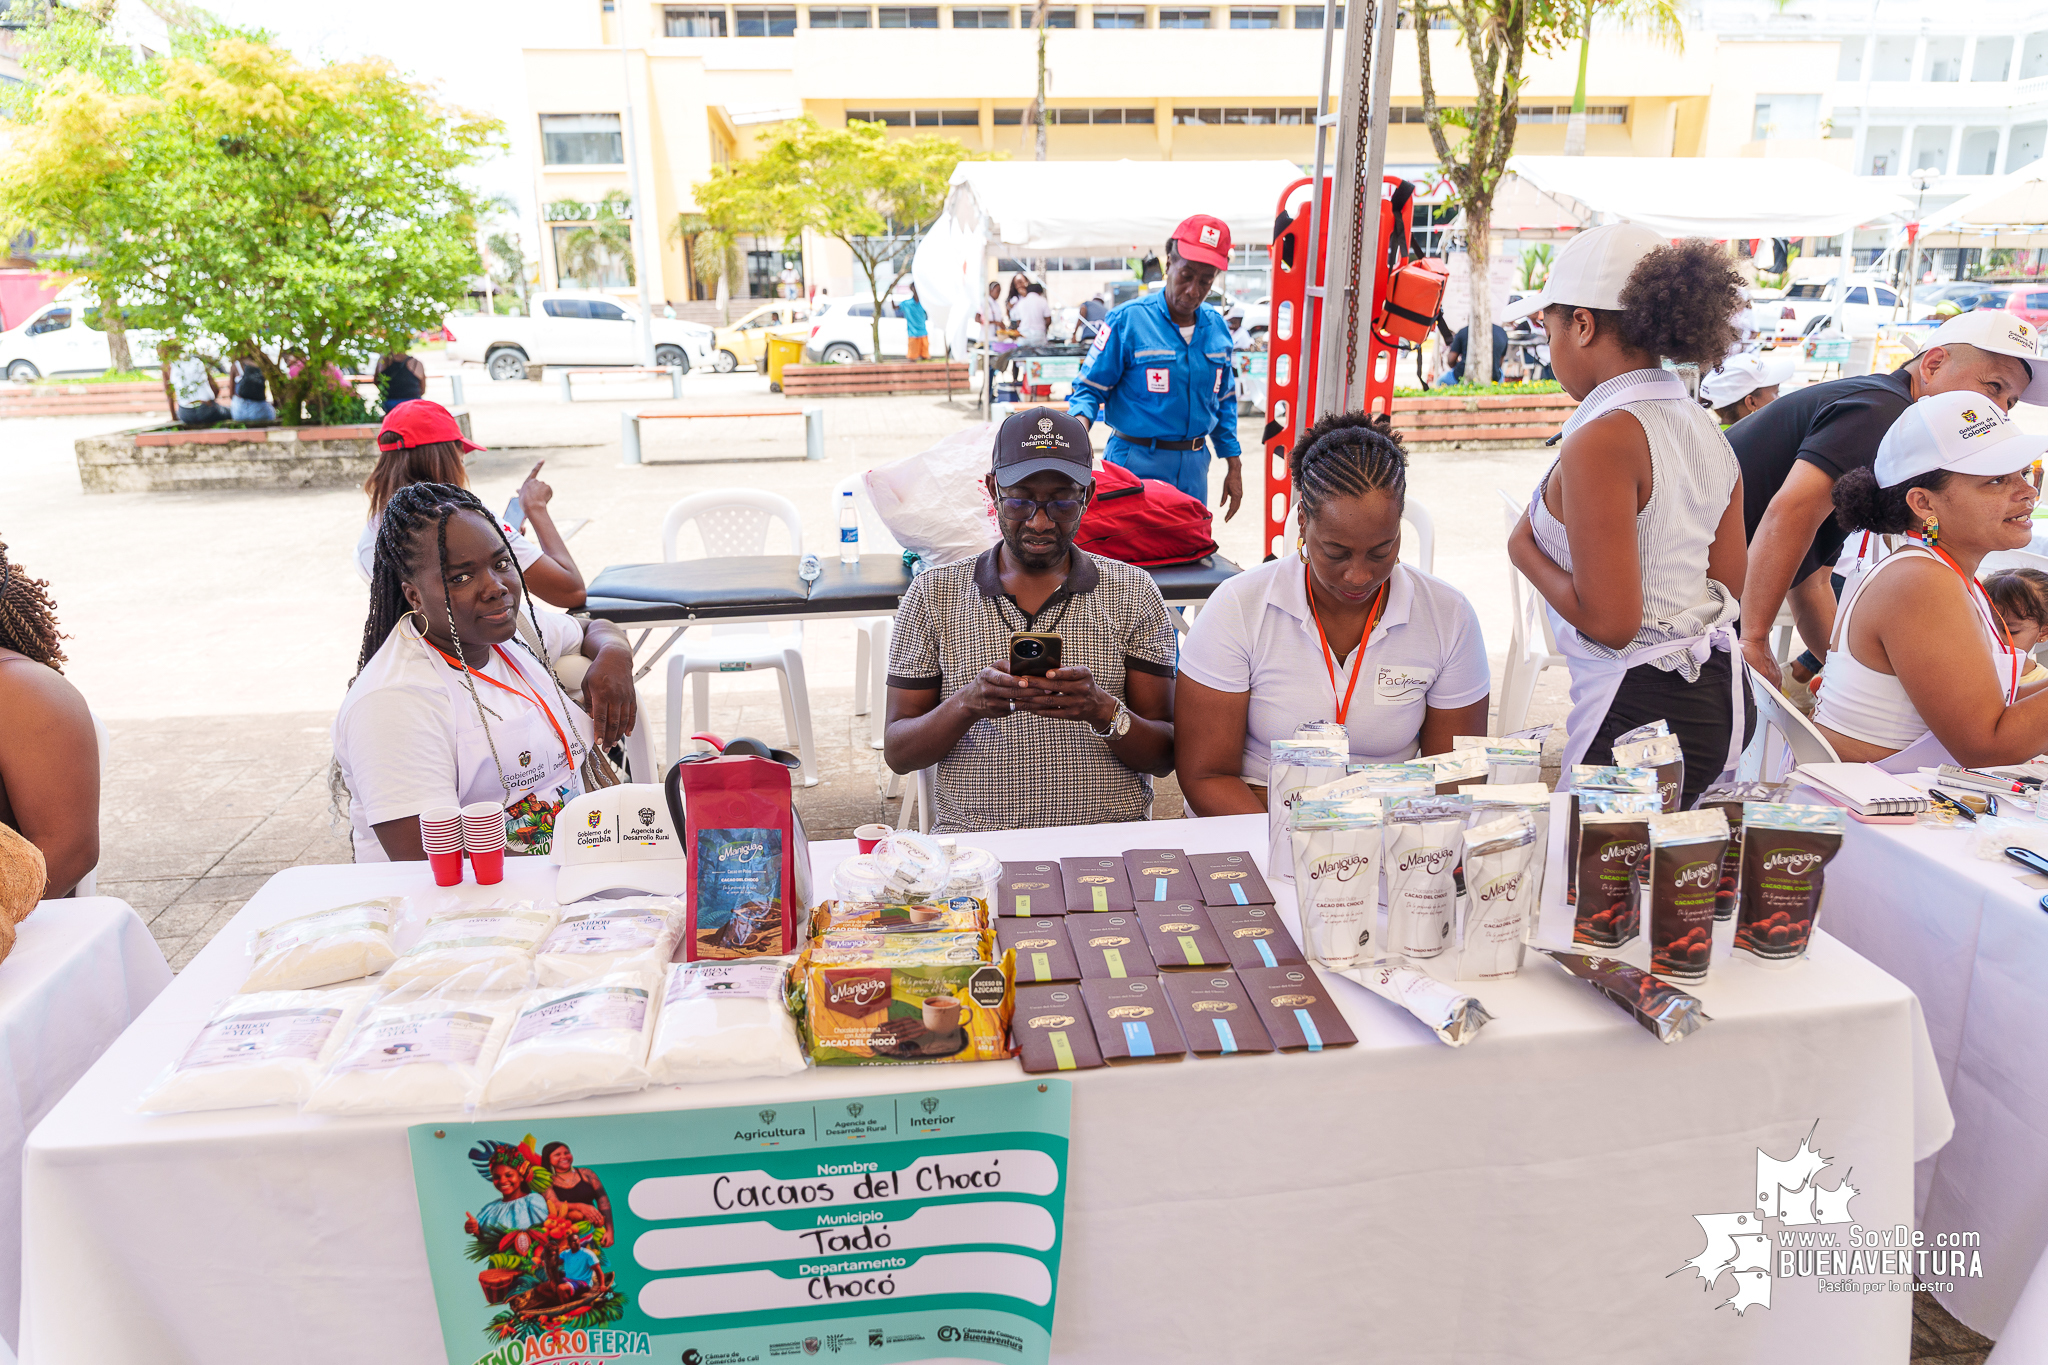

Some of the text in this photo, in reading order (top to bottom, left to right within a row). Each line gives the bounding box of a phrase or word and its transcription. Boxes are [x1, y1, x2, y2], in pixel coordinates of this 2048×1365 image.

[2008, 334, 2033, 350] Colombia
[1959, 421, 1985, 435] Gobierno
[1962, 421, 1997, 440] Colombia
[1029, 433, 1054, 441] Agencia
[1021, 440, 1070, 448] Desarrollo Rural
[503, 767, 536, 781] Gobierno
[577, 829, 601, 837] Gobierno
[577, 835, 611, 845] Colombia
[973, 986, 1004, 994] AZÚCARES
[233, 1028, 264, 1036] YUCA
[387, 1028, 418, 1037] YUCA
[819, 1036, 896, 1047] CACAO DEL CHOCÓ
[835, 1120, 866, 1130] Agencia
[910, 1114, 956, 1127] Interior
[734, 1127, 806, 1142] Agricultura
[825, 1124, 887, 1136] Desarrollo Rural
[817, 1160, 879, 1177] Nombre
[713, 1159, 1001, 1211] Cacaos del Chocó
[816, 1209, 884, 1227] Municipio
[799, 1225, 892, 1255] Tadó
[799, 1256, 907, 1276] Departamento
[807, 1275, 896, 1300] Chocó
[963, 1332, 1023, 1350] Buenaventura
[996, 1330, 1023, 1343] Comercio
